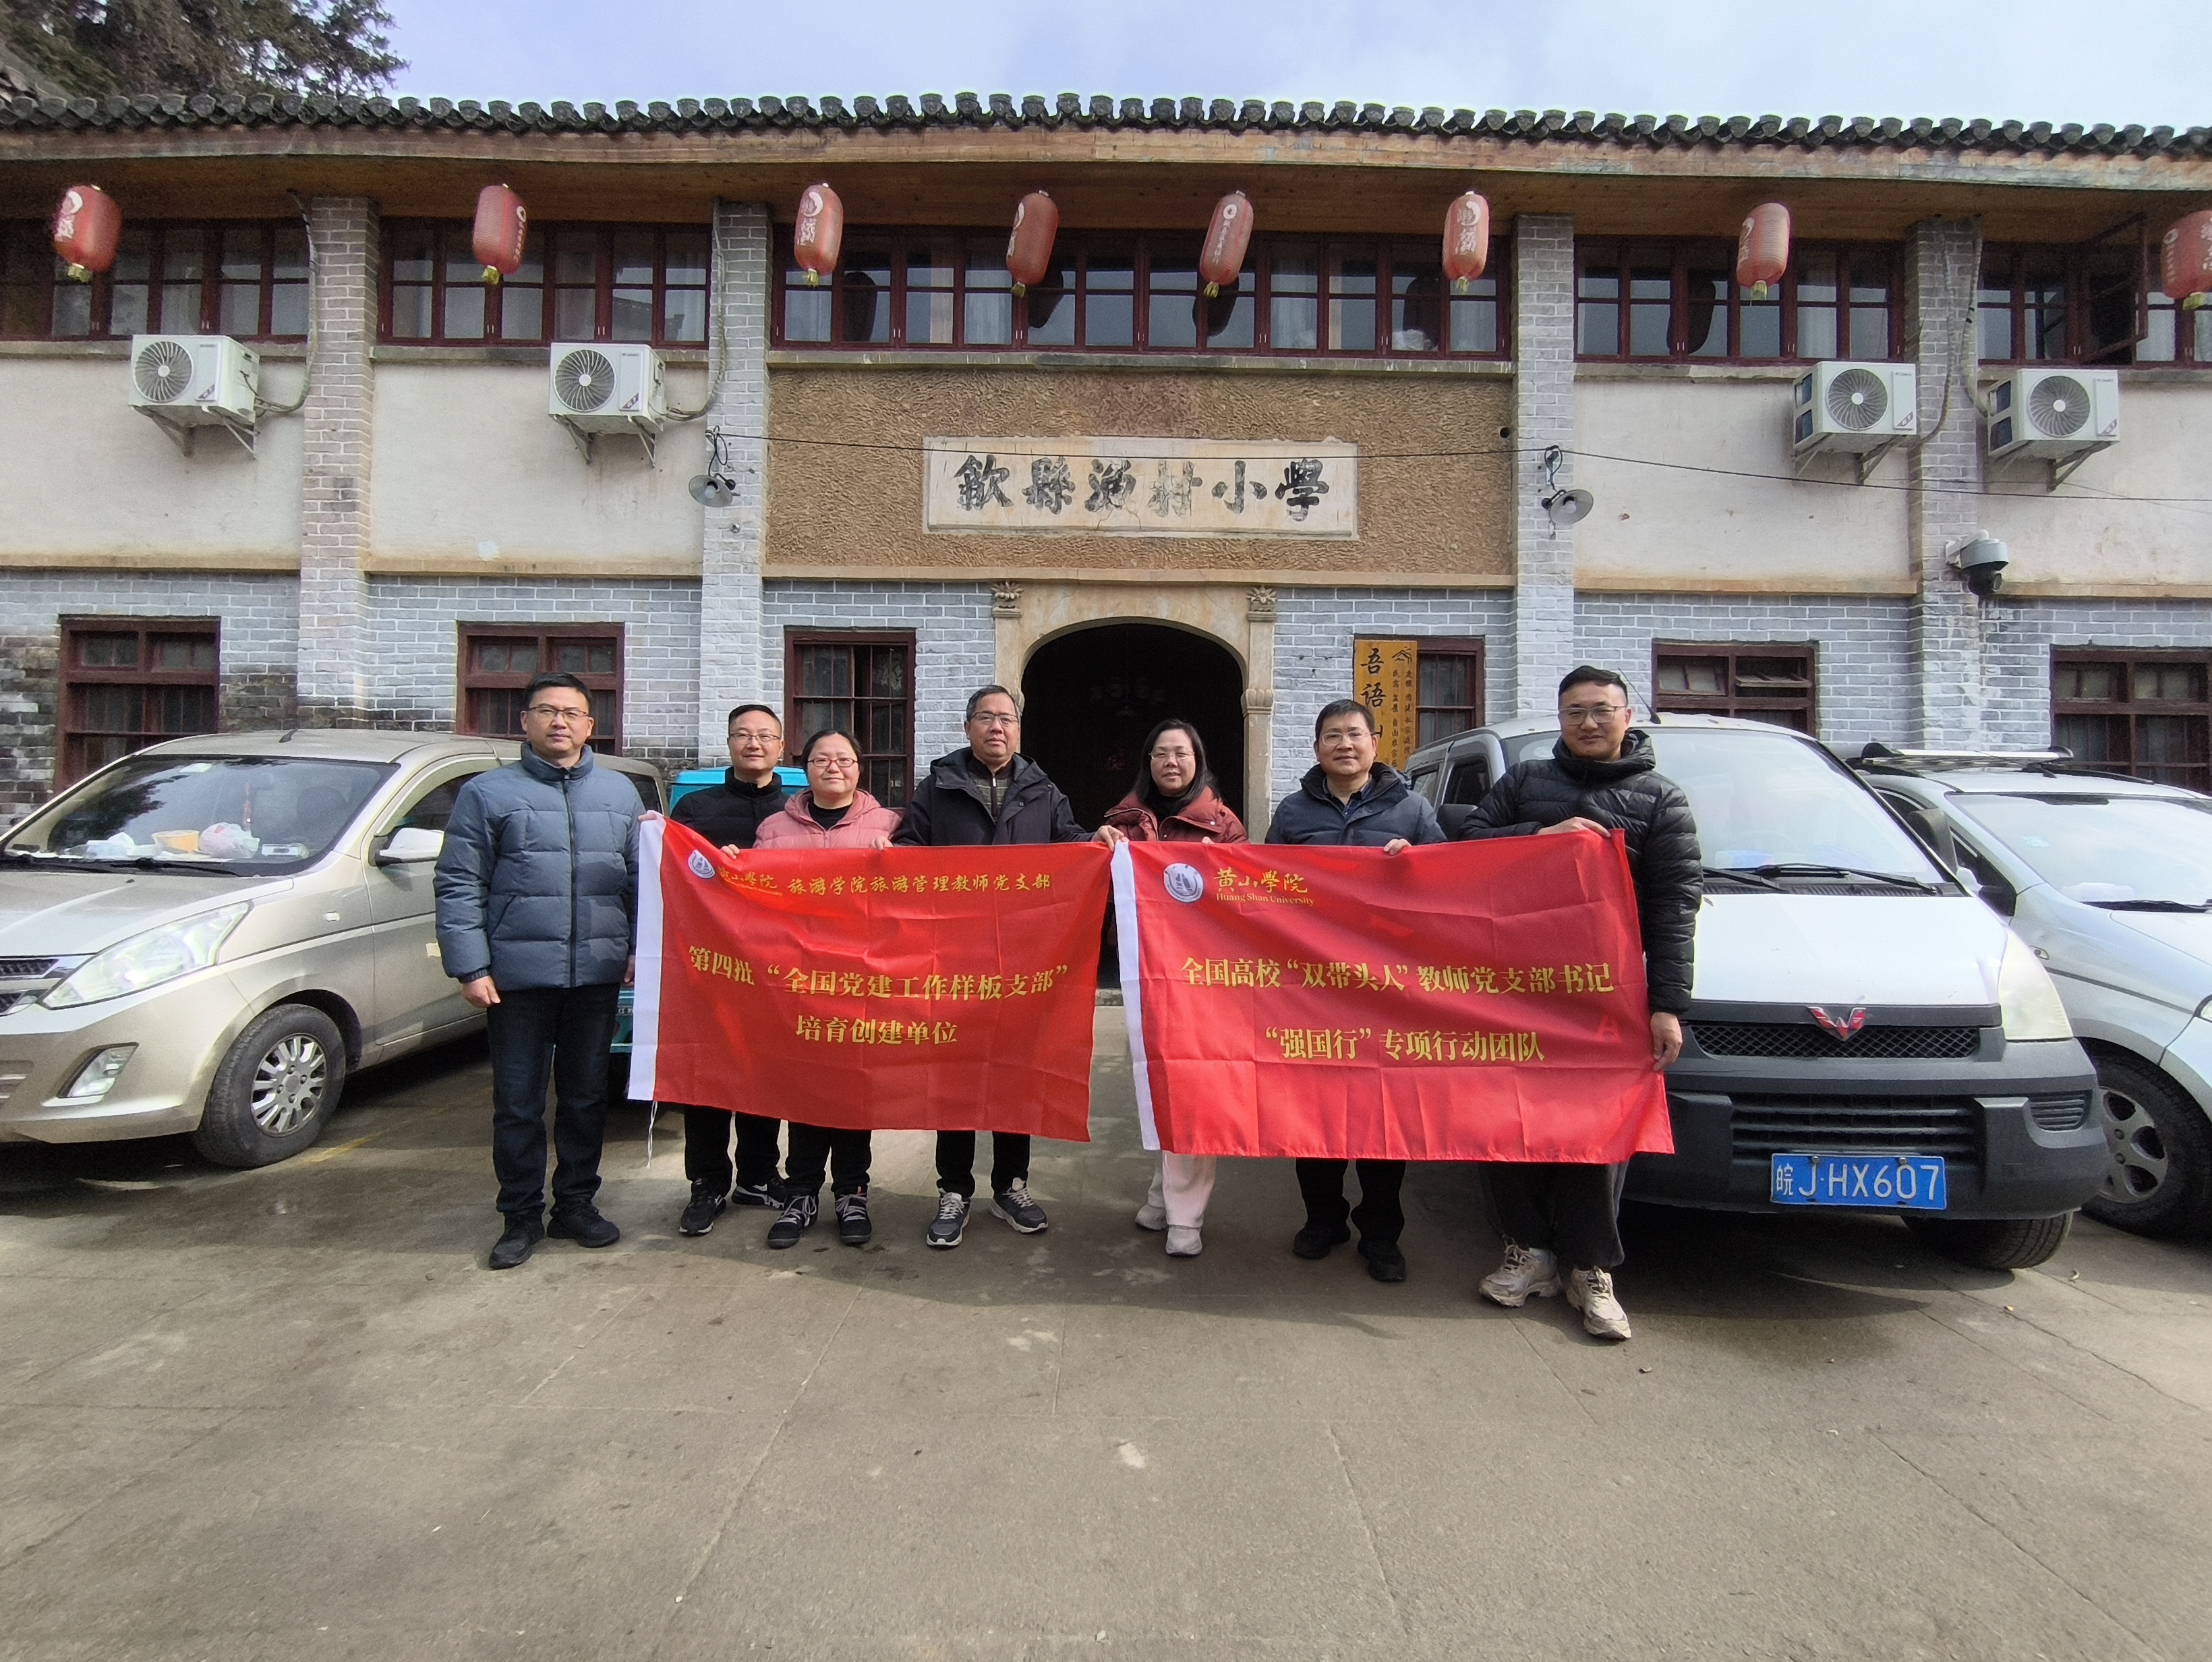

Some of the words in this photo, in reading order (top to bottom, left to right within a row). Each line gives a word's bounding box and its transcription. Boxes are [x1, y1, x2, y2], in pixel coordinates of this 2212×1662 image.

[1216, 893, 1245, 902] Huang
[1247, 893, 1269, 902] Shan
[1270, 895, 1315, 907] University
[796, 1014, 958, 1045] 培育创建单位
